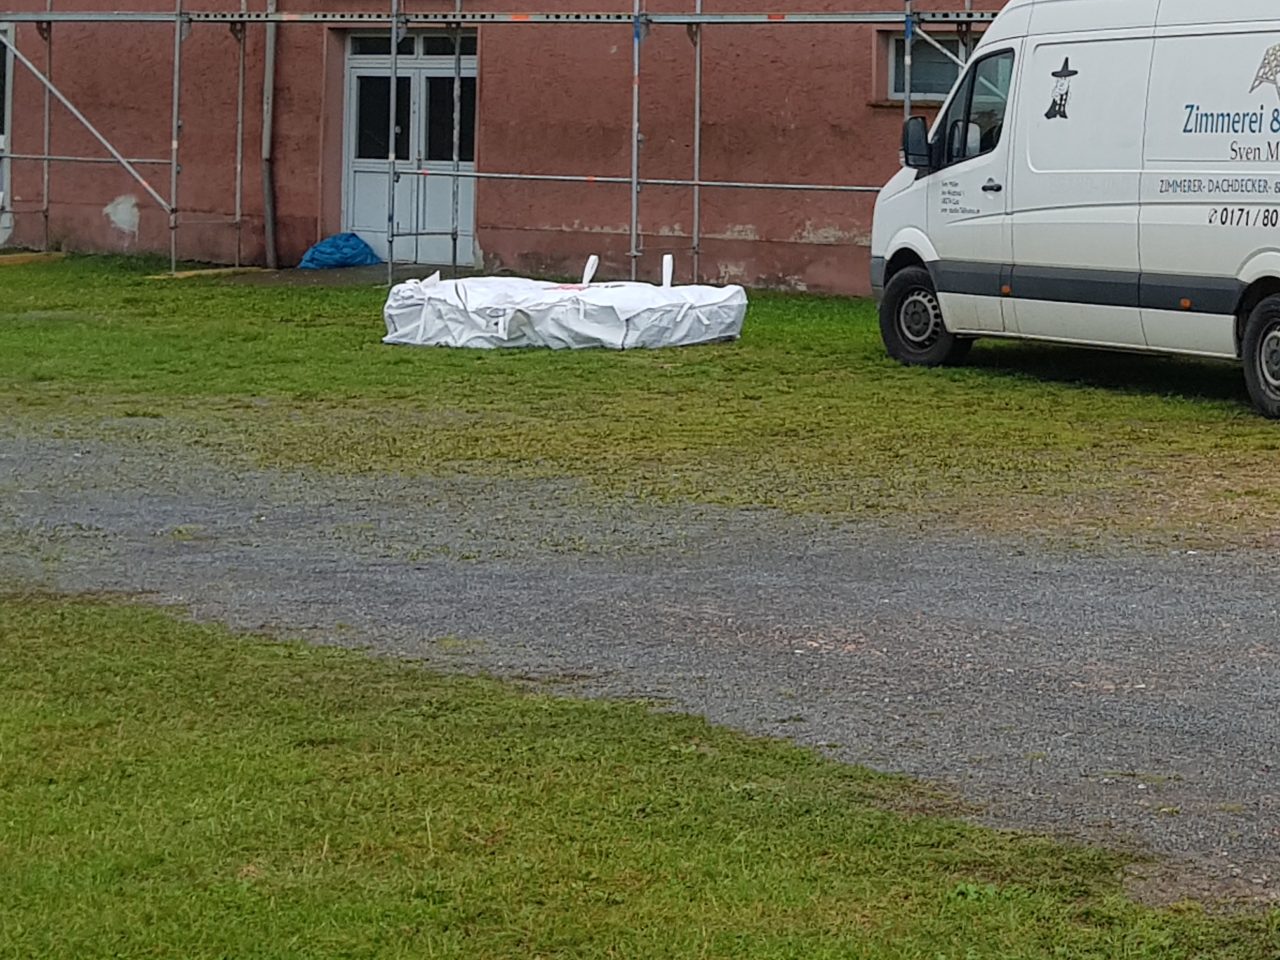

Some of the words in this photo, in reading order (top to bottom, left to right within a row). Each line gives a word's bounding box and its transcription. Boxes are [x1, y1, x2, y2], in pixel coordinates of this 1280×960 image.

[1182, 103, 1264, 134] Zimmerei
[1230, 140, 1261, 161] Sven
[1220, 207, 1250, 227] 0171
[1262, 209, 1278, 228] 80
